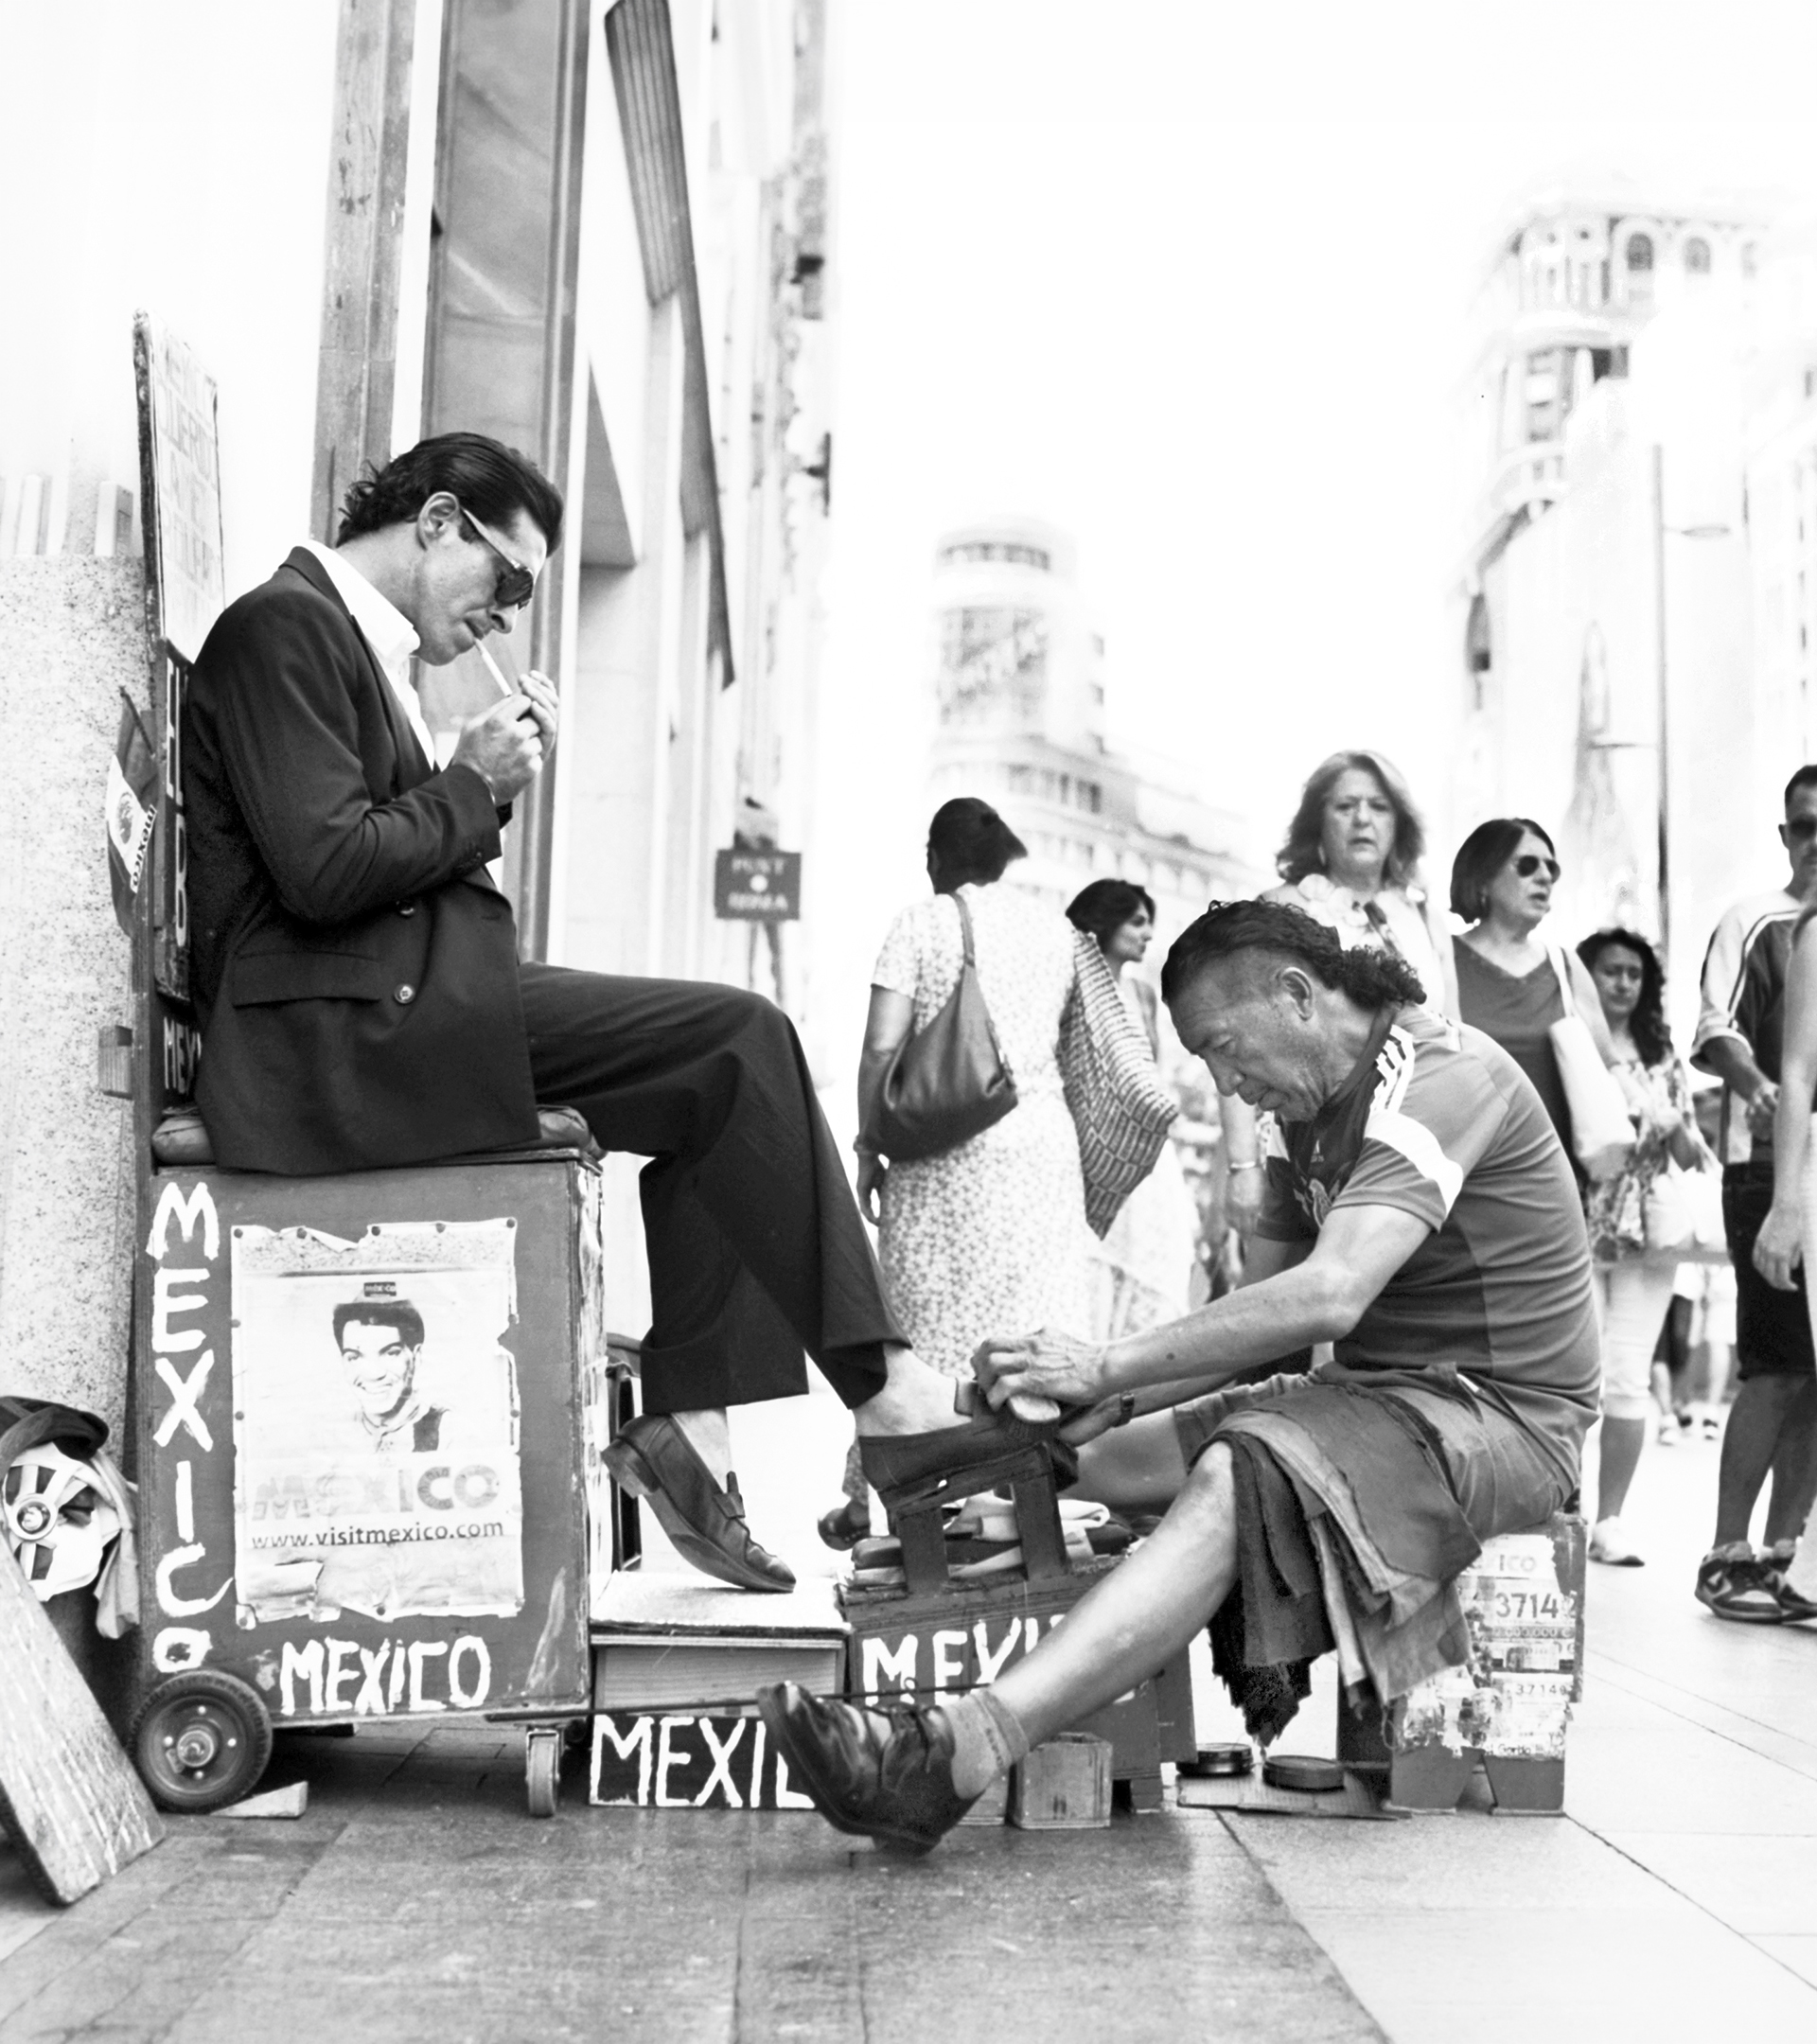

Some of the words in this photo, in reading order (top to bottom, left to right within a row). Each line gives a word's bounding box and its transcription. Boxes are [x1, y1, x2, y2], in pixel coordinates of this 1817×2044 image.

[146, 1182, 234, 1672] MEXICO
[252, 1521, 503, 1549] www.visitmexico.com
[279, 1635, 491, 1716] MEXICO
